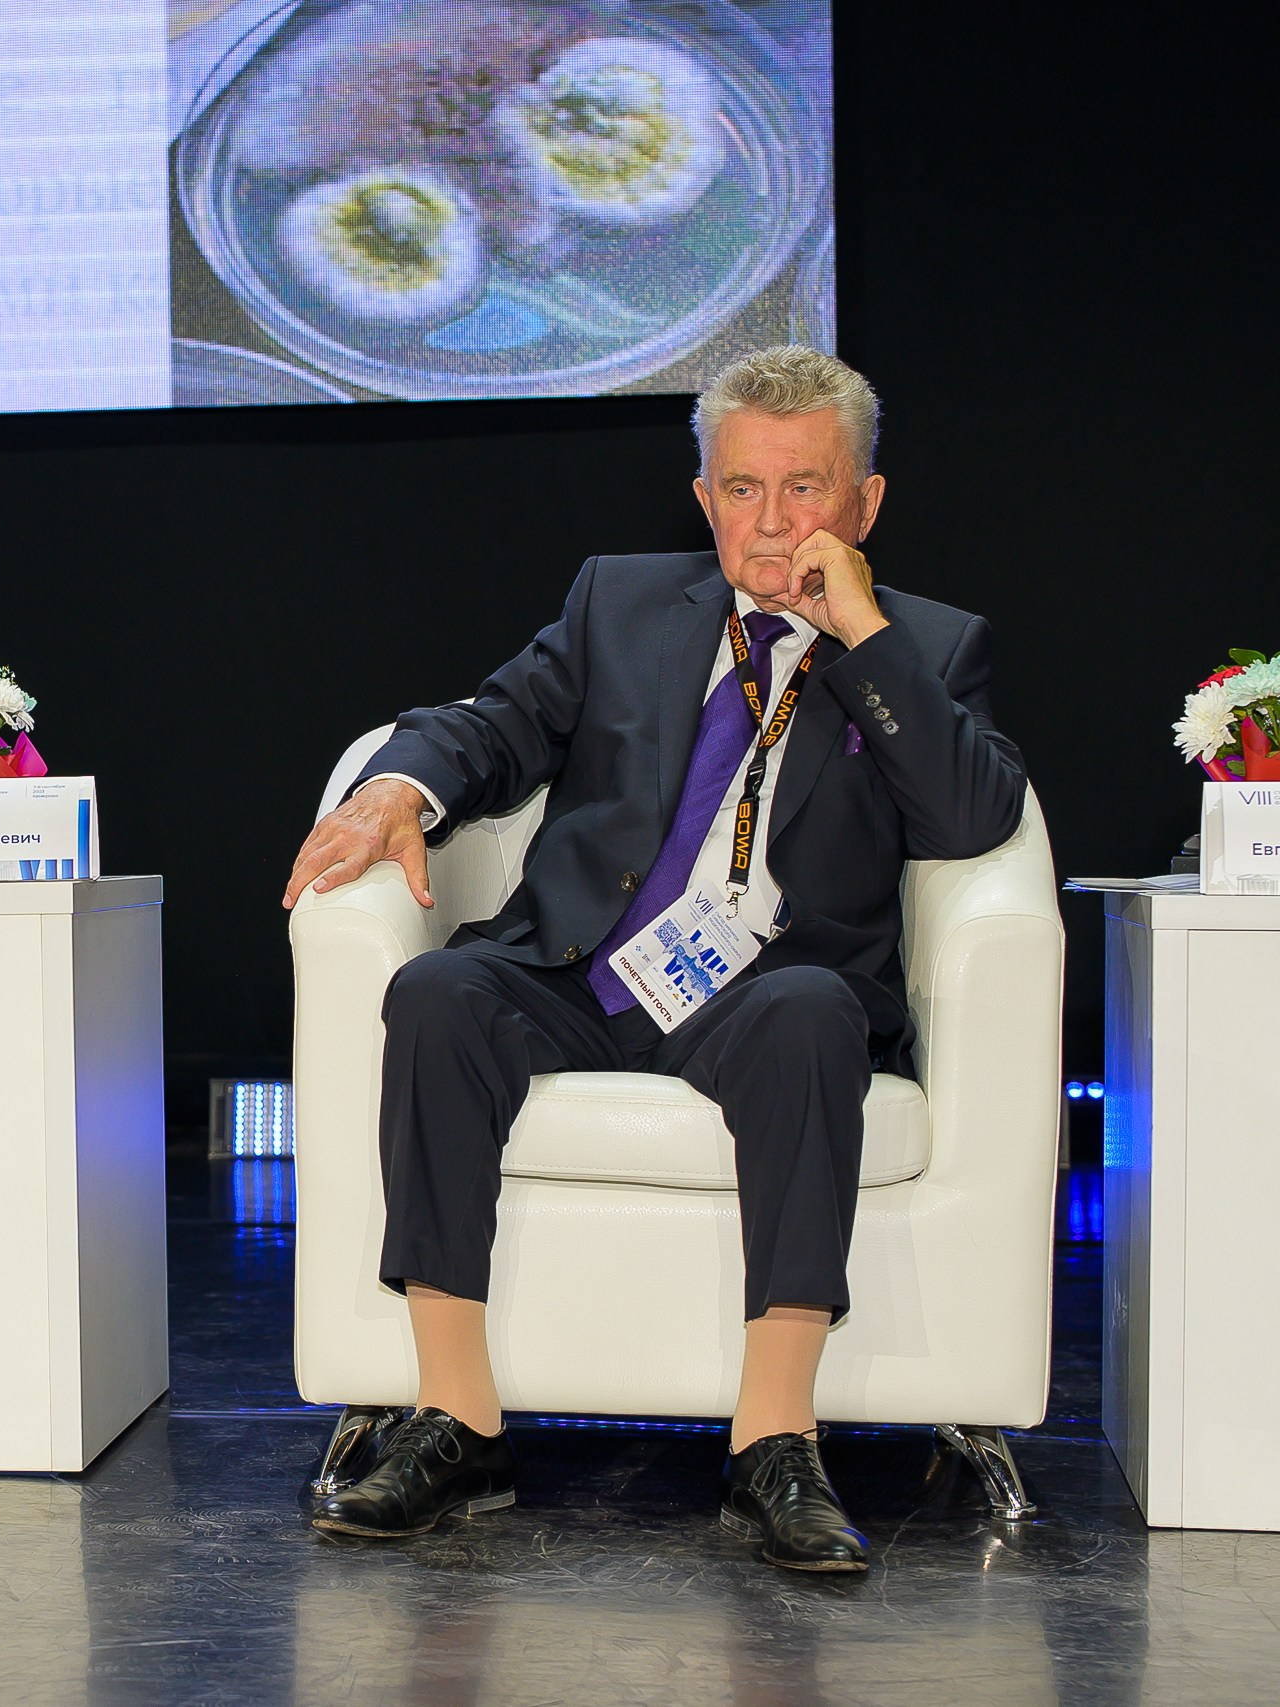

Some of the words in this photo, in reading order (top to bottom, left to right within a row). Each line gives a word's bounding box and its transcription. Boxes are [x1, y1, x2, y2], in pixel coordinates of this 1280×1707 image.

[764, 690, 798, 746] BOWA
[1238, 790, 1271, 805] VIII
[735, 803, 750, 869] BOWA
[695, 890, 714, 915] VIII
[619, 956, 656, 1000] ПОЧЕТНЫЙ
[652, 998, 673, 1023] ГОСТЬ
